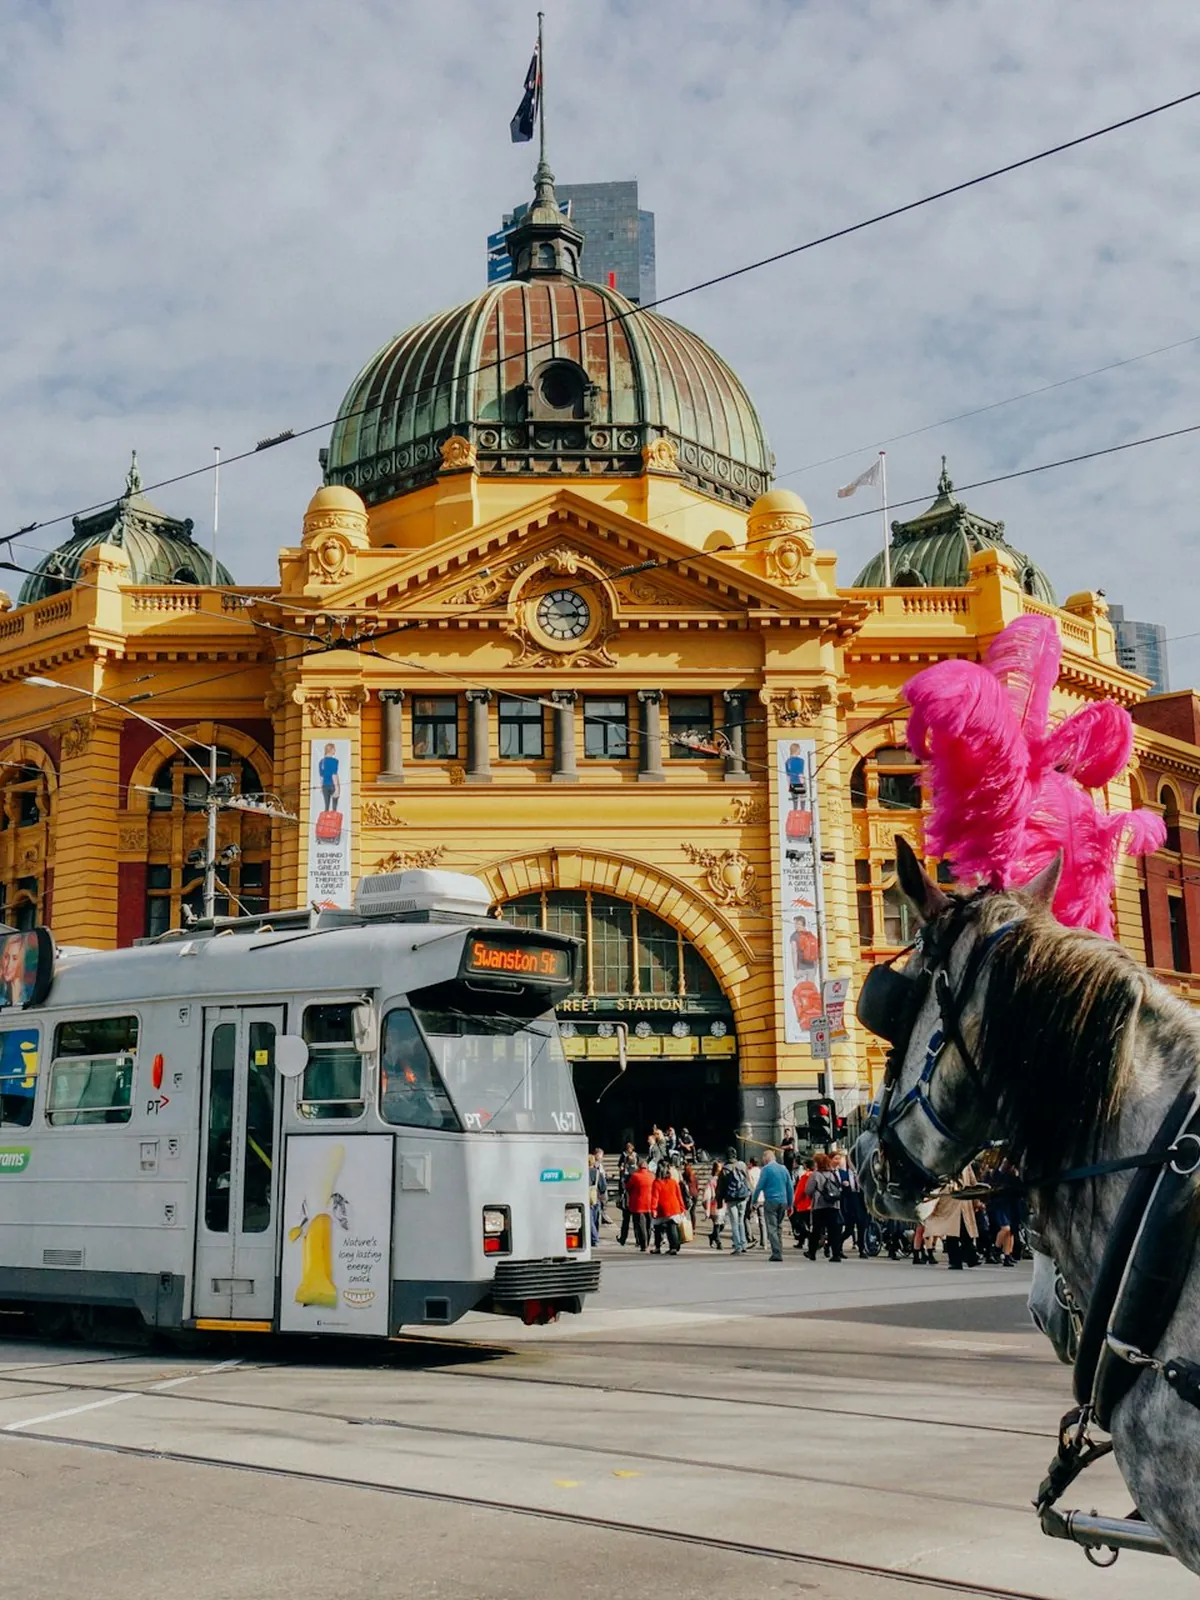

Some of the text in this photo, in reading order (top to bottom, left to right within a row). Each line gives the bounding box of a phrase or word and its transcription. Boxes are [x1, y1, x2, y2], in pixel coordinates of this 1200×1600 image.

[473, 942, 557, 974] Swanston St
[556, 998, 684, 1012] REET STATION
[551, 1111, 577, 1132] 167
[0, 1153, 25, 1167] rams
[343, 1236, 378, 1247] Nature's
[339, 1249, 382, 1263] long lasting
[346, 1264, 373, 1276] energy
[348, 1275, 371, 1283] snack
